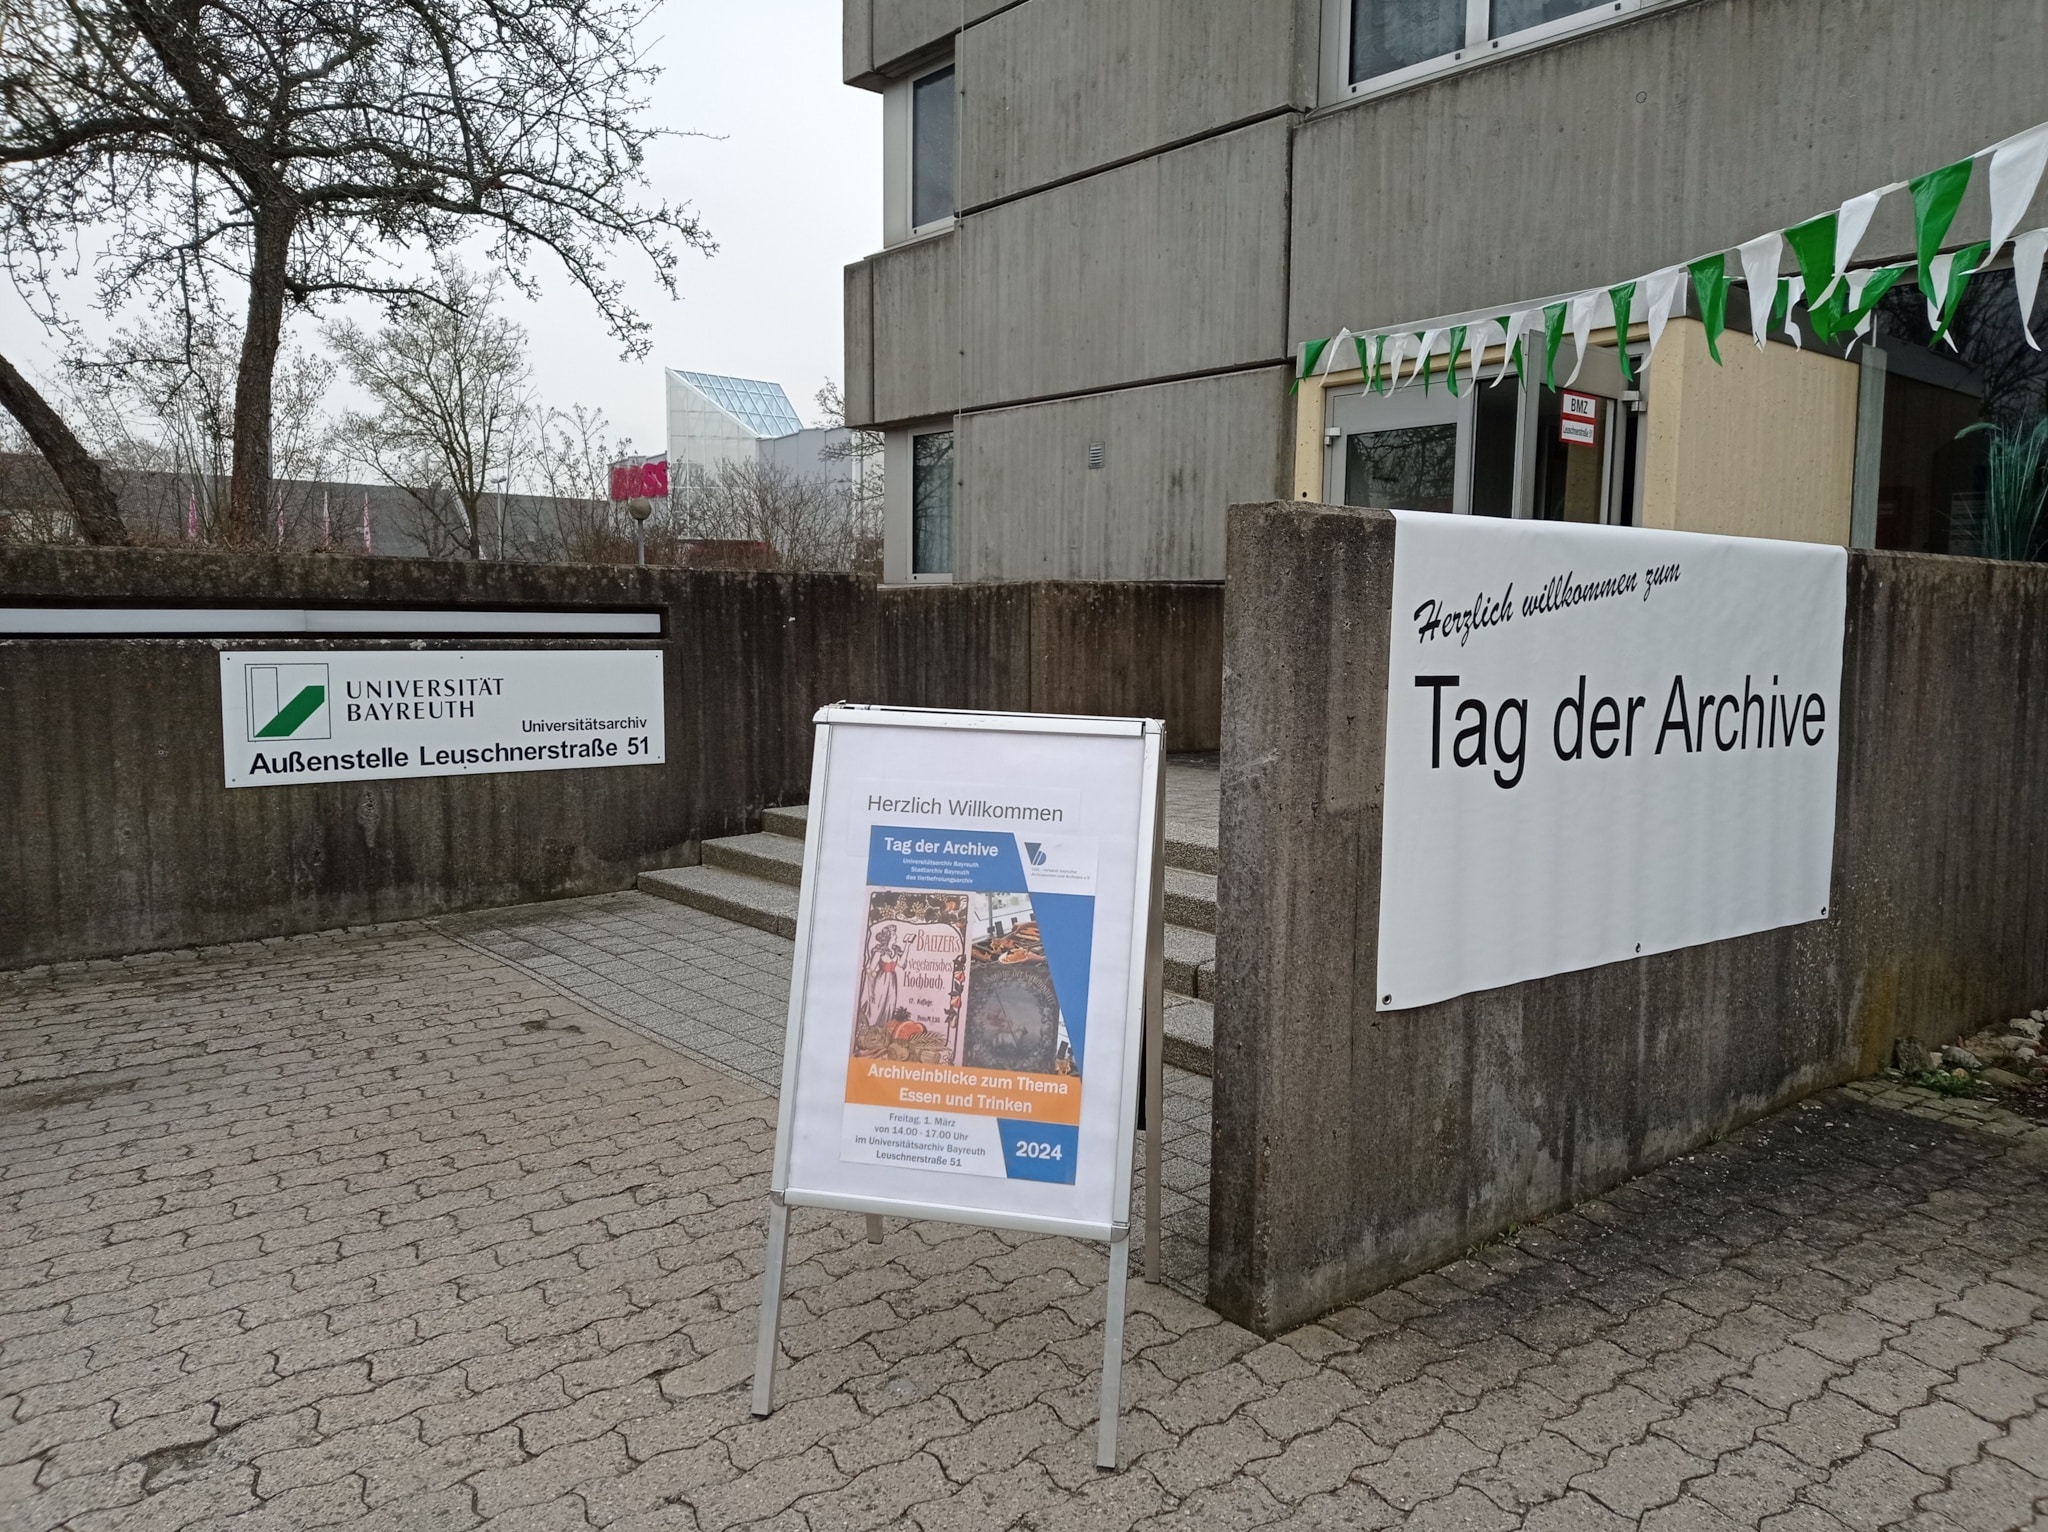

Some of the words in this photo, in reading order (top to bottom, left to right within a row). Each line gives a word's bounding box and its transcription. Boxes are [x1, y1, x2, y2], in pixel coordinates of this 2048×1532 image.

[1571, 398, 1588, 414] BMZ
[1414, 582, 1514, 647] Herzlich
[1522, 571, 1638, 618] willkommen
[1644, 562, 1681, 602] zum
[346, 677, 505, 699] UNIVERSITÄT
[346, 700, 474, 722] BAYREUTH
[522, 716, 648, 733] Universitätsarchiv
[1414, 675, 1528, 790] Tag
[1553, 674, 1646, 762] der
[1655, 674, 1826, 755] Archive
[249, 747, 410, 776] Außenstelle
[419, 738, 618, 766] Leuschnerstraße
[626, 736, 650, 756] 51
[867, 794, 942, 815] Herzlich
[948, 799, 1064, 822] Willkommen
[884, 836, 912, 855] Tag
[915, 840, 940, 854] der
[943, 840, 998, 856] Archive
[902, 858, 952, 866] Universitätsarchiv
[953, 860, 980, 868] Bayreuth
[868, 1063, 978, 1086] Archiveinblicke
[981, 1076, 1012, 1090] zum
[1017, 1076, 1068, 1095] Thema
[900, 1088, 941, 1104] Essen
[946, 1094, 973, 1108] und
[977, 1094, 1032, 1113] Trinken
[923, 1116, 932, 1126] 1.
[934, 1116, 956, 1128] März
[874, 1126, 890, 1134] von
[892, 1126, 918, 1136] 14.00
[926, 1129, 951, 1139] 17.00
[953, 1132, 969, 1142] Uhr
[855, 1135, 867, 1144] im
[869, 1136, 945, 1152] Universitätsarchiv
[946, 1144, 986, 1156] Bayreuth
[1016, 1140, 1062, 1161] 2024
[876, 1150, 947, 1166] Leuschnerstraße
[950, 1157, 962, 1167] 51
